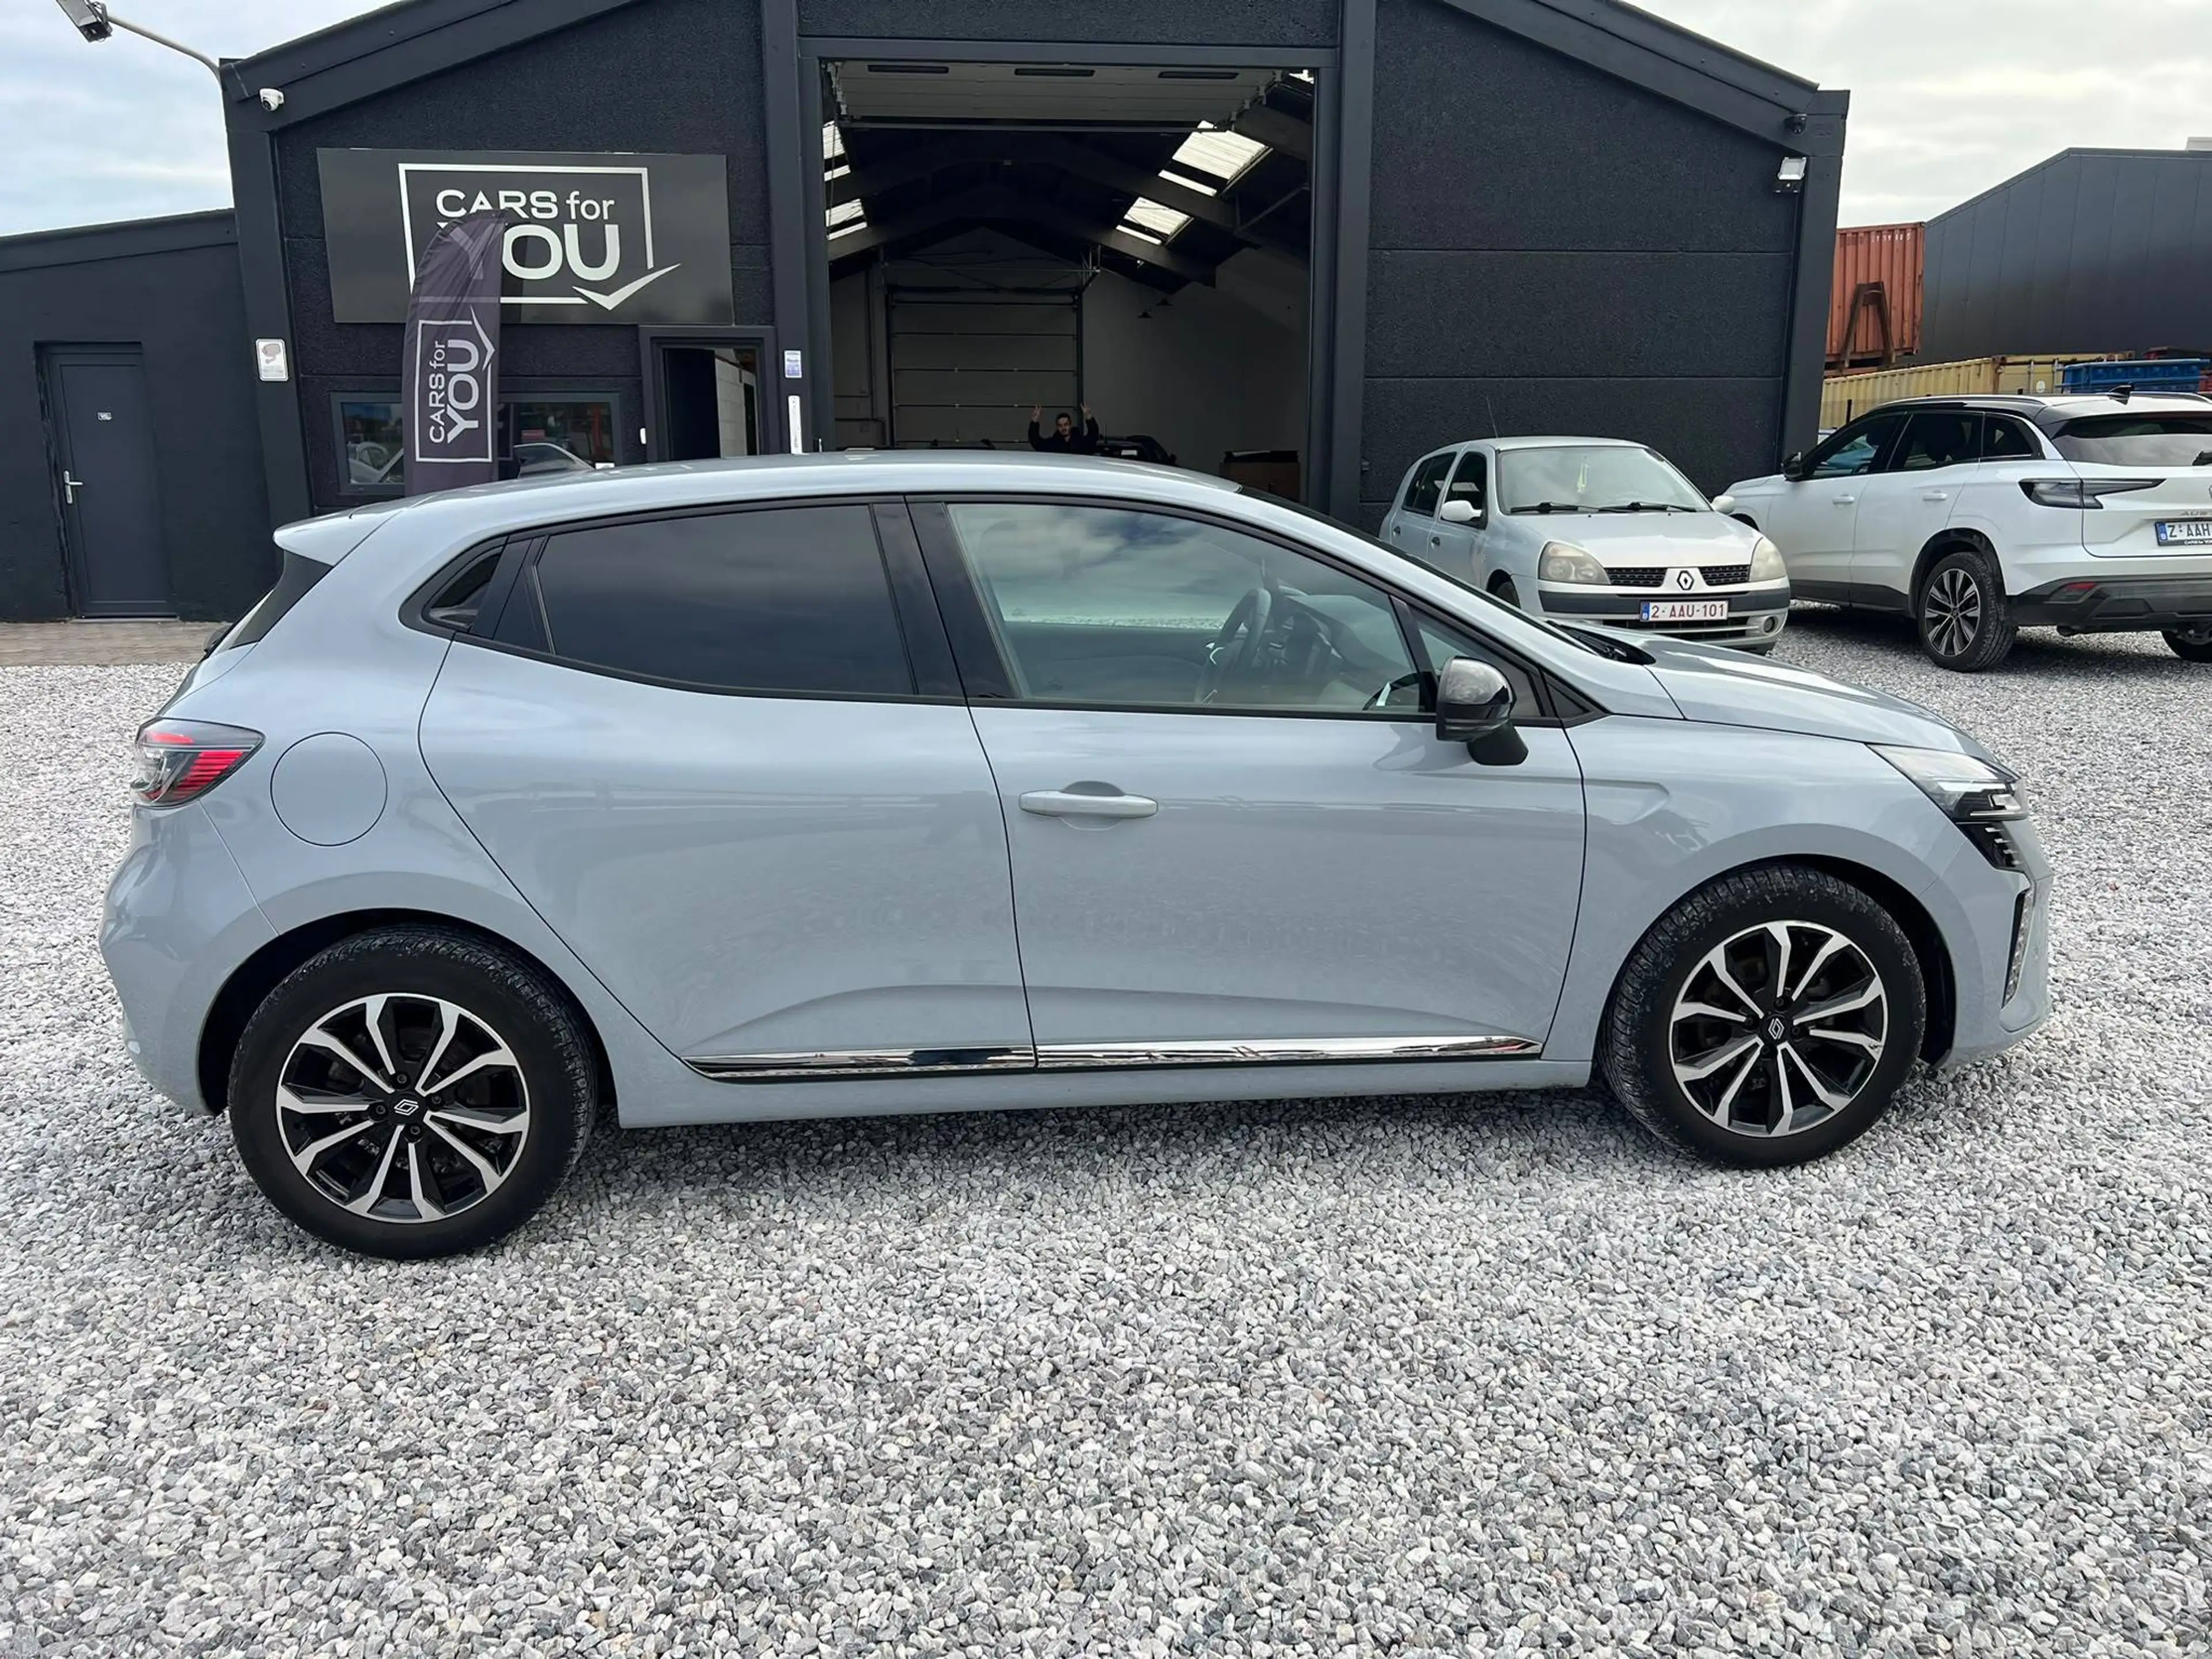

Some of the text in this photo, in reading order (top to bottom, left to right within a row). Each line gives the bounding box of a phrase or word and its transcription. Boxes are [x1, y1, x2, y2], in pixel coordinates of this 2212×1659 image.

[436, 190, 615, 219] CARS for
[429, 340, 445, 443] CARS for
[447, 339, 479, 444] YOU
